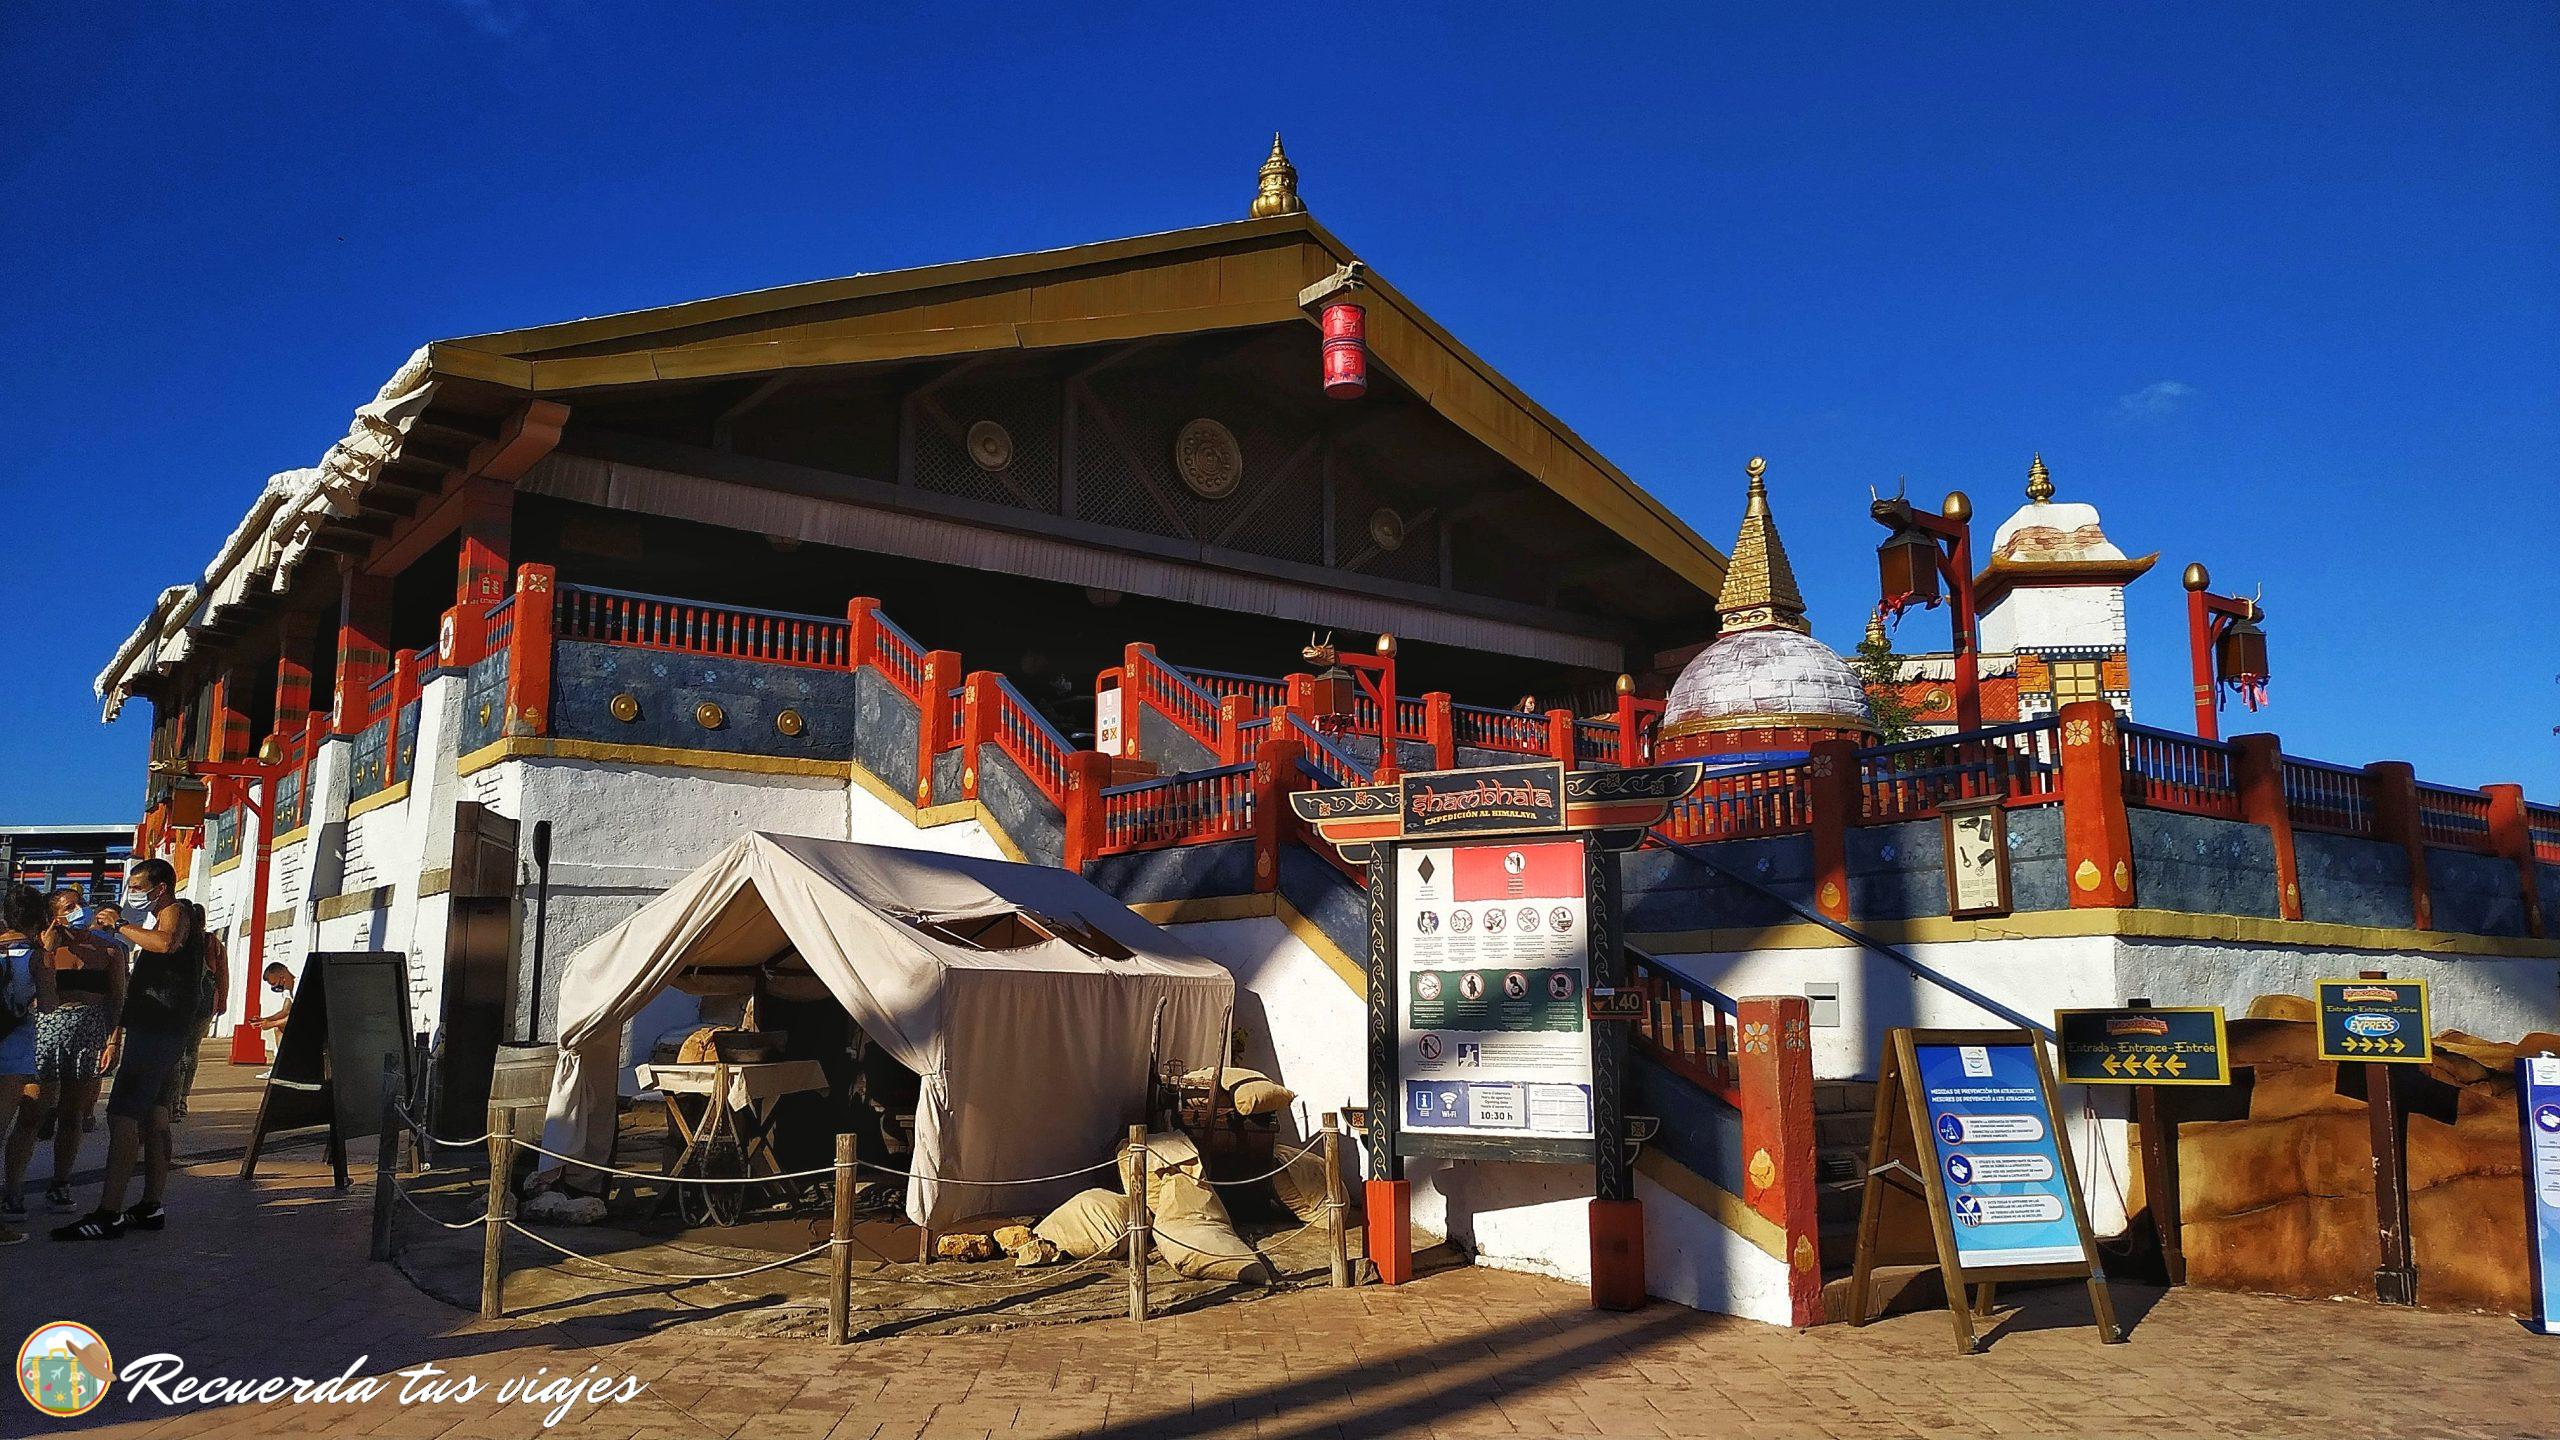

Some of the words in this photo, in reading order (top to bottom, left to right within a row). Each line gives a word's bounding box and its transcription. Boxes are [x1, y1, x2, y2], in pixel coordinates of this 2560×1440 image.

[1424, 810, 1479, 826] EXPEDICIÓN
[1492, 810, 1536, 820] HIMALAYA
[2350, 1020, 2395, 1036] EXPRESS
[1481, 1112, 1505, 1120] 10:30
[1508, 1112, 1513, 1120] h
